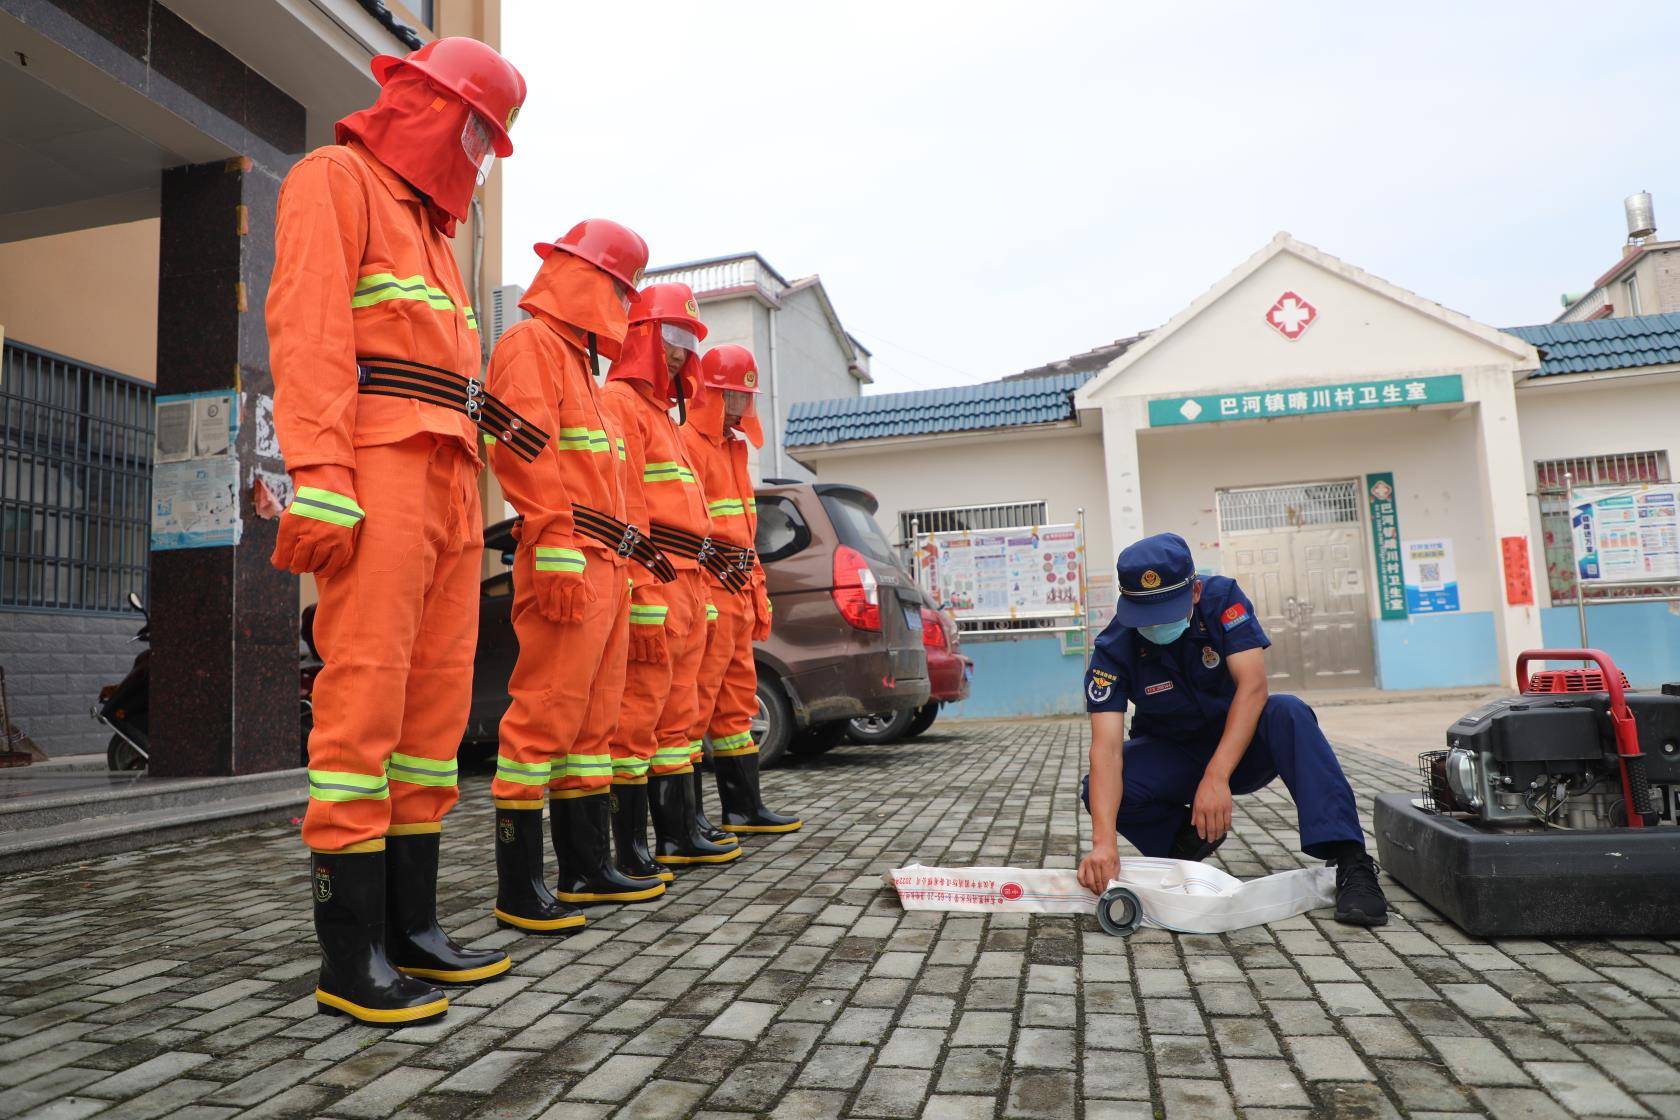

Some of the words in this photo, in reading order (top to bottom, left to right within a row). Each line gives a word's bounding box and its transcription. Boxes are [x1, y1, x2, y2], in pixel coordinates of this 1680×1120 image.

[1220, 382, 1428, 415] 巴河镇晴川村卫生室
